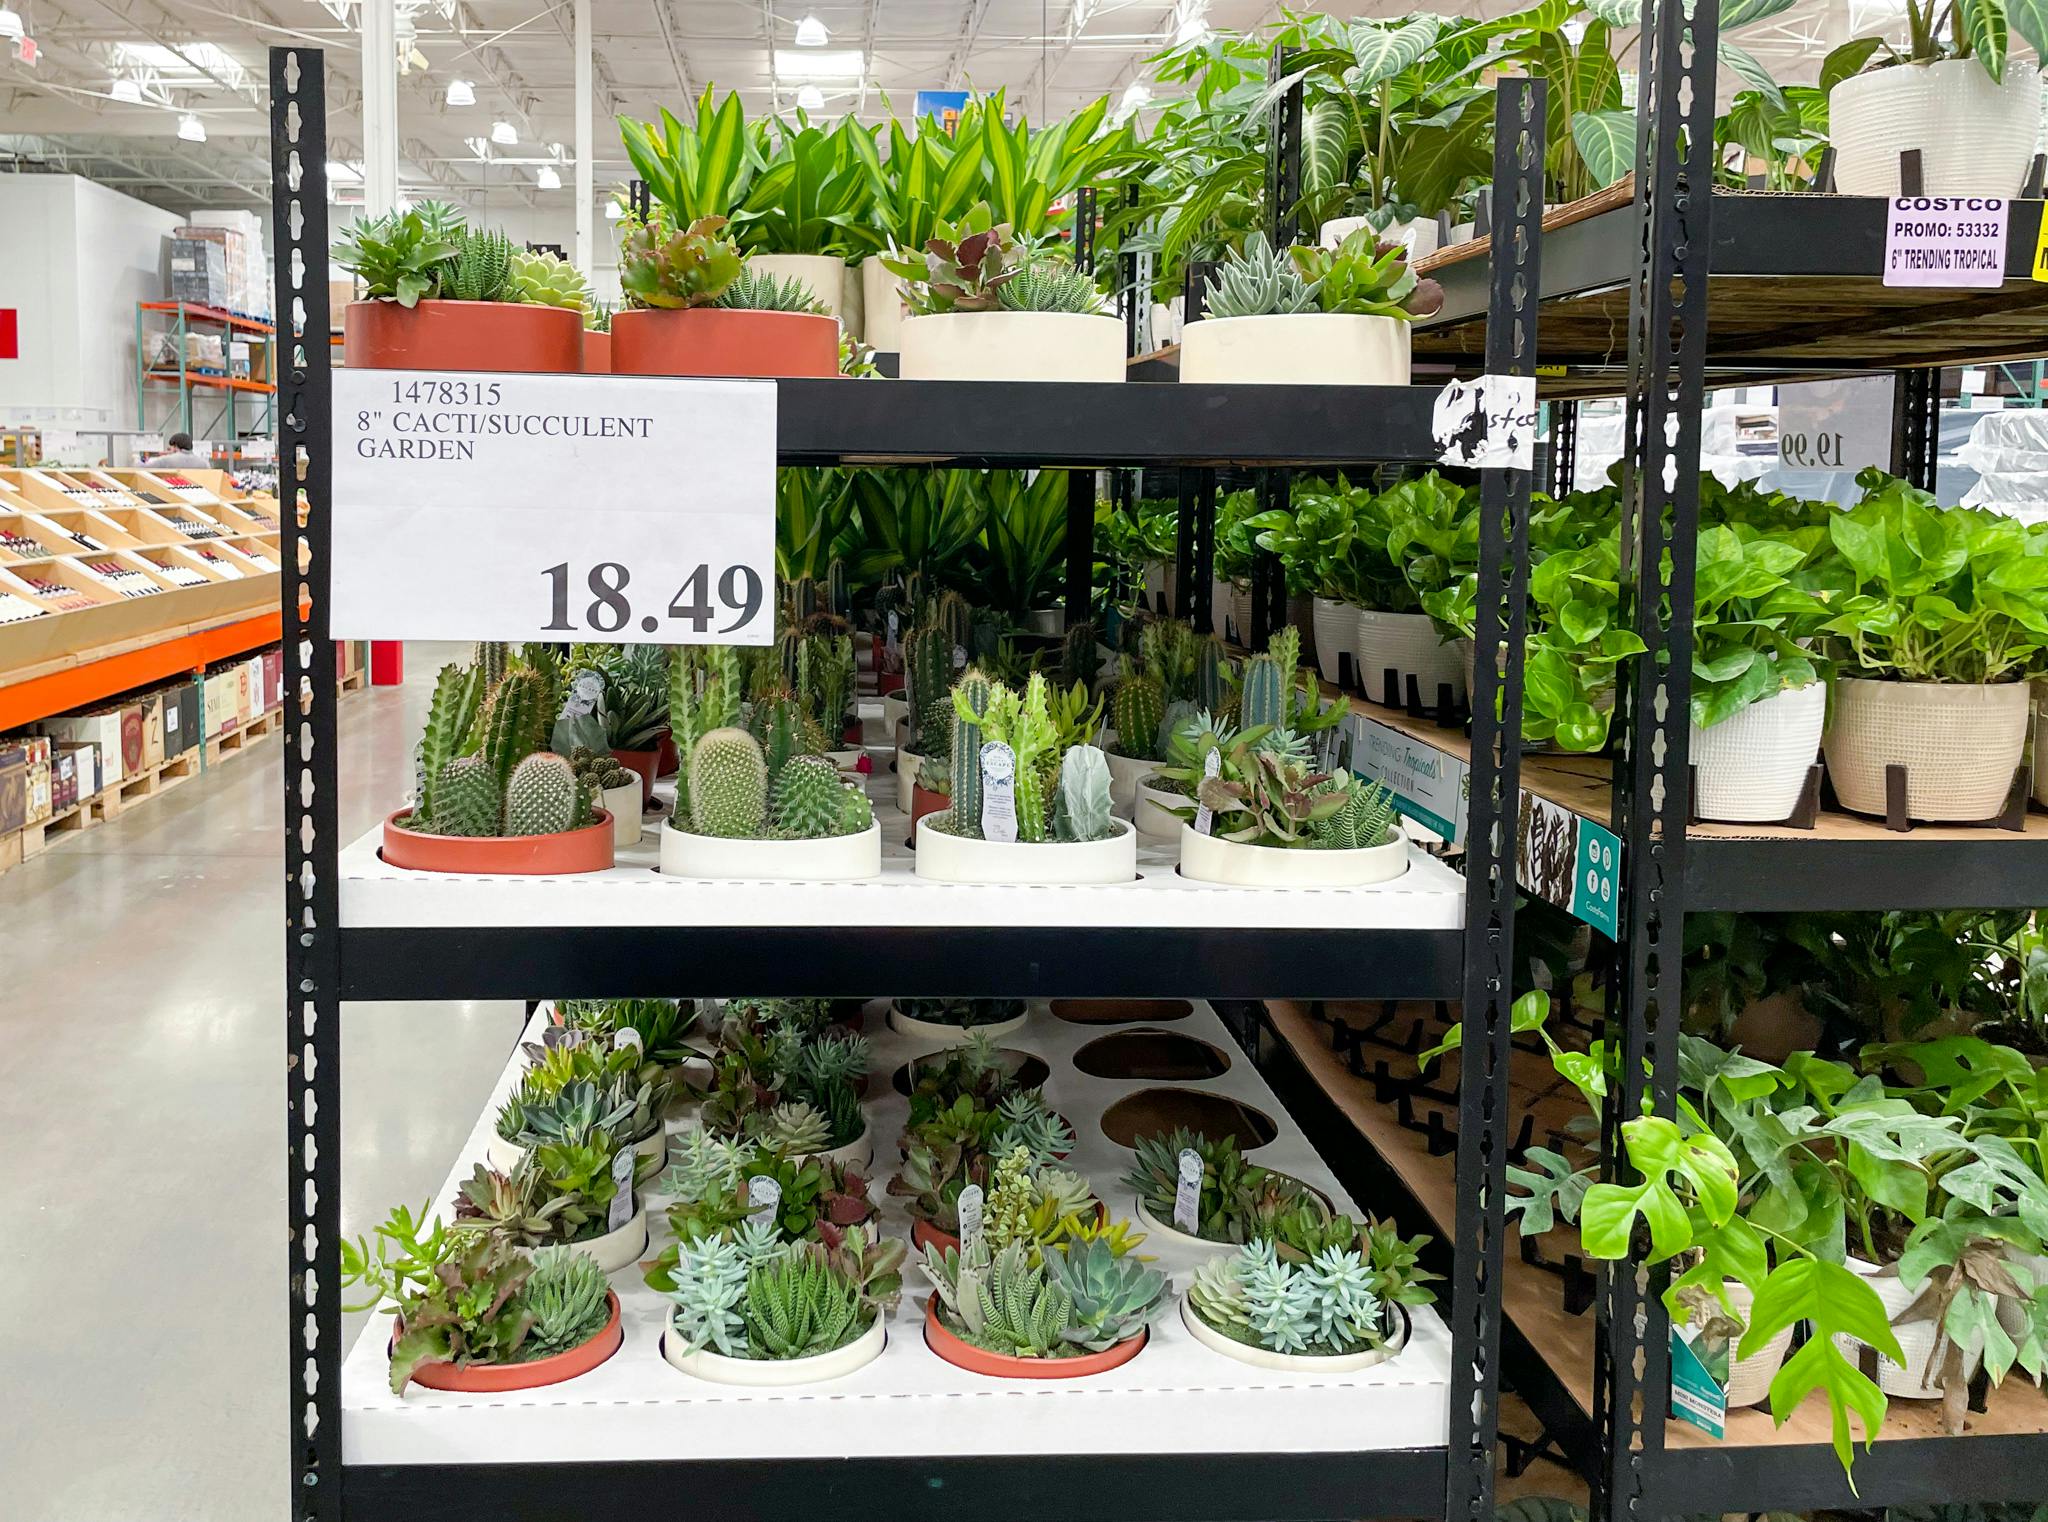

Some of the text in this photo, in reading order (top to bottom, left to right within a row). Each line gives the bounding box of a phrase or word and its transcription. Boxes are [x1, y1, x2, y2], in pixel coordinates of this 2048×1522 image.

[1894, 198, 2002, 211] COSTCO
[1894, 222, 1999, 238] PROMO: 53332
[1891, 248, 1998, 270] 6" TRENDING TROPICAL
[392, 380, 502, 406] 1478315
[357, 410, 654, 439] 8" CACTI/SUCCULENT
[357, 438, 475, 461] GARDEN
[540, 561, 764, 635] 18.49
[1403, 747, 1436, 780] Tropicals
